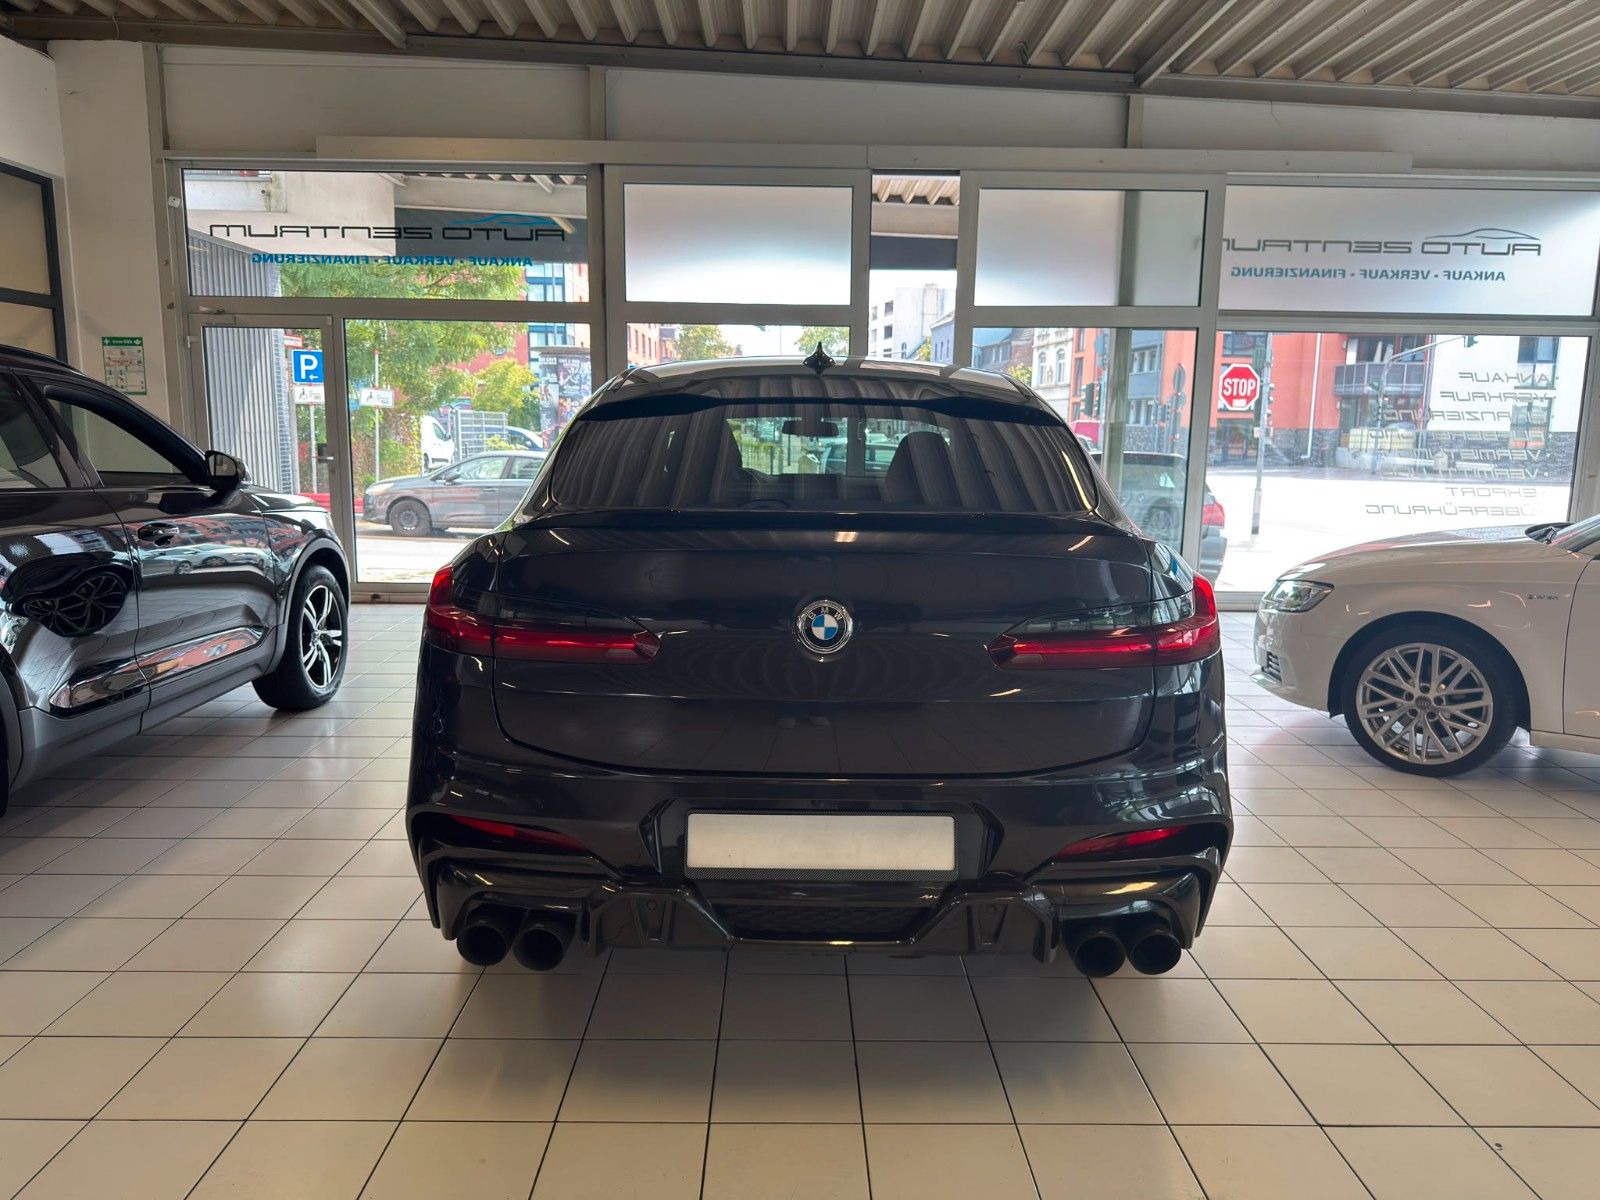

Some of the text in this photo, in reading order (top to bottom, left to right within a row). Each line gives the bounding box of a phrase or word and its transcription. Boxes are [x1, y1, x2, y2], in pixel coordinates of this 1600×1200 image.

[299, 354, 319, 380] P
[1222, 377, 1257, 397] STOP
[808, 606, 843, 621] BMW
